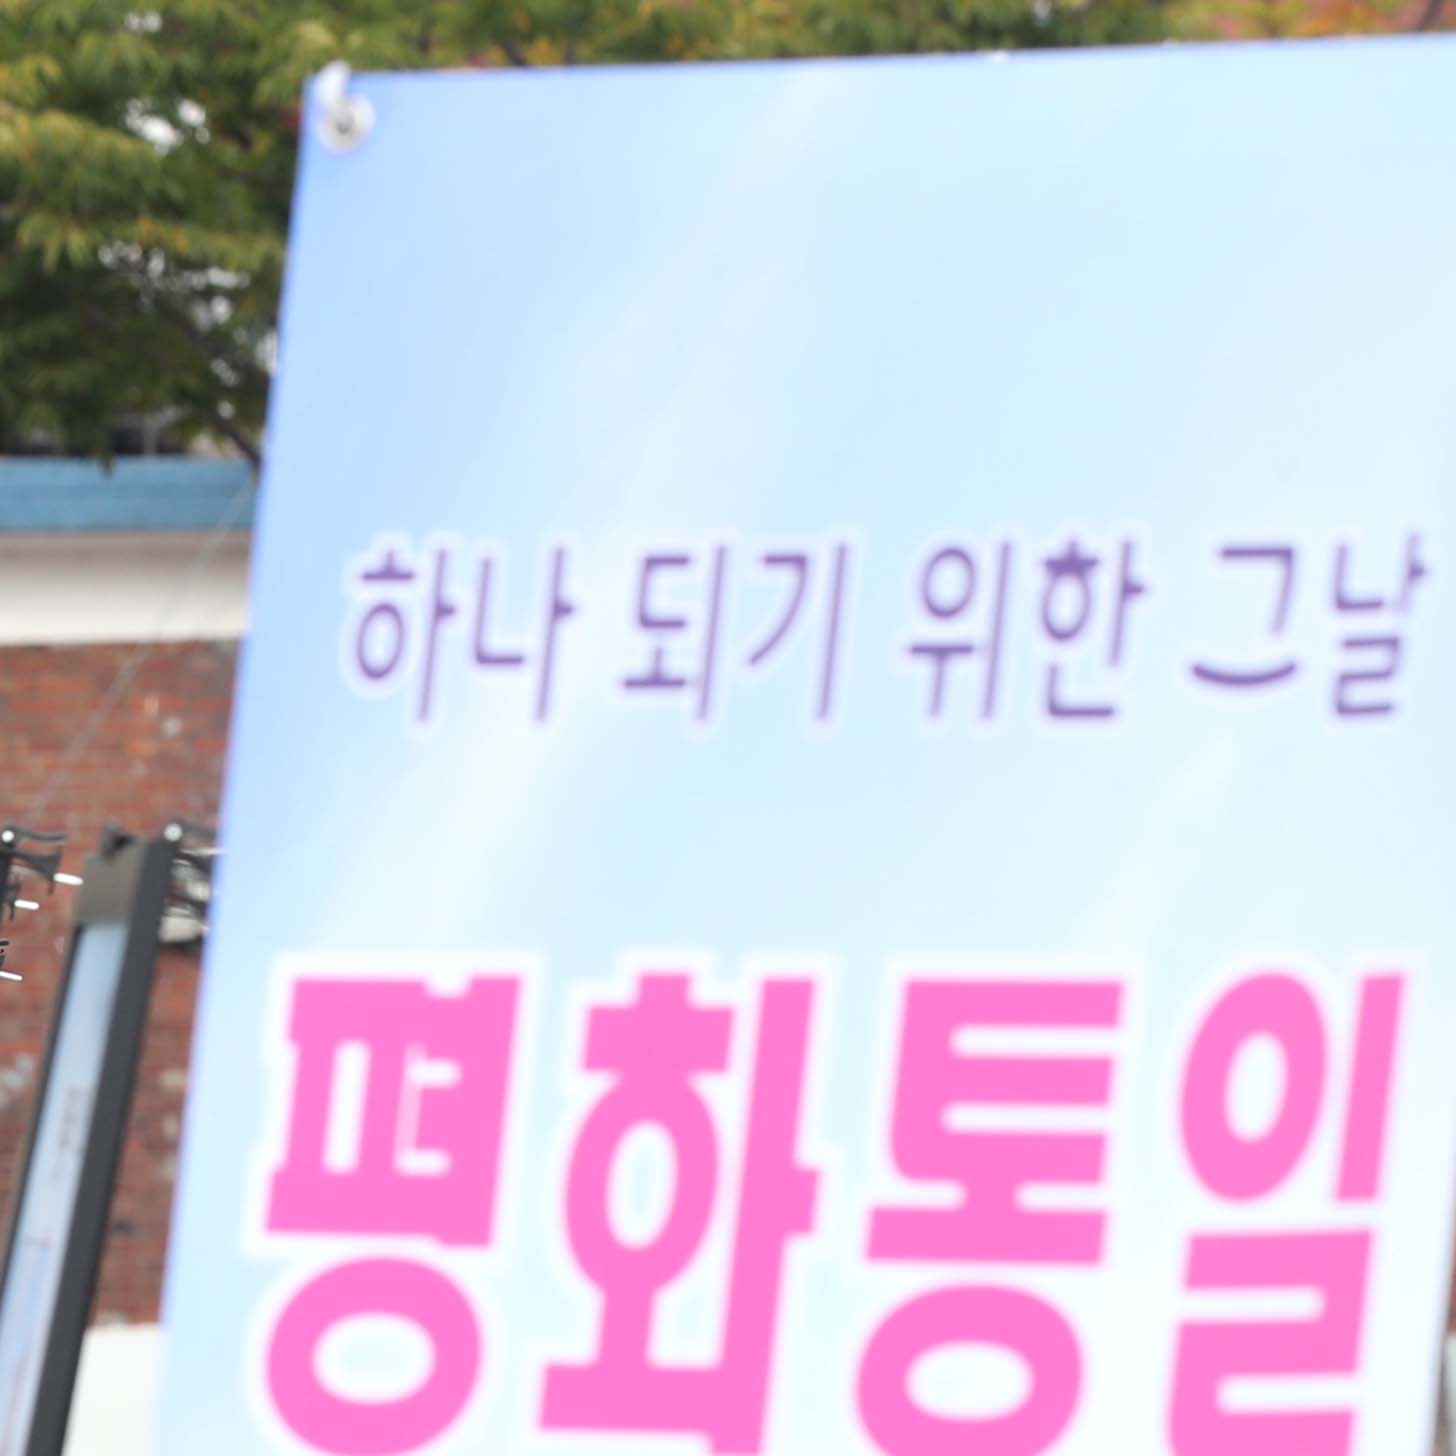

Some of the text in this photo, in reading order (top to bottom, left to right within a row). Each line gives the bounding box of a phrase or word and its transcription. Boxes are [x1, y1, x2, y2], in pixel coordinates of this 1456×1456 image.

[353, 534, 1429, 722] 하나 되기 위한 그날
